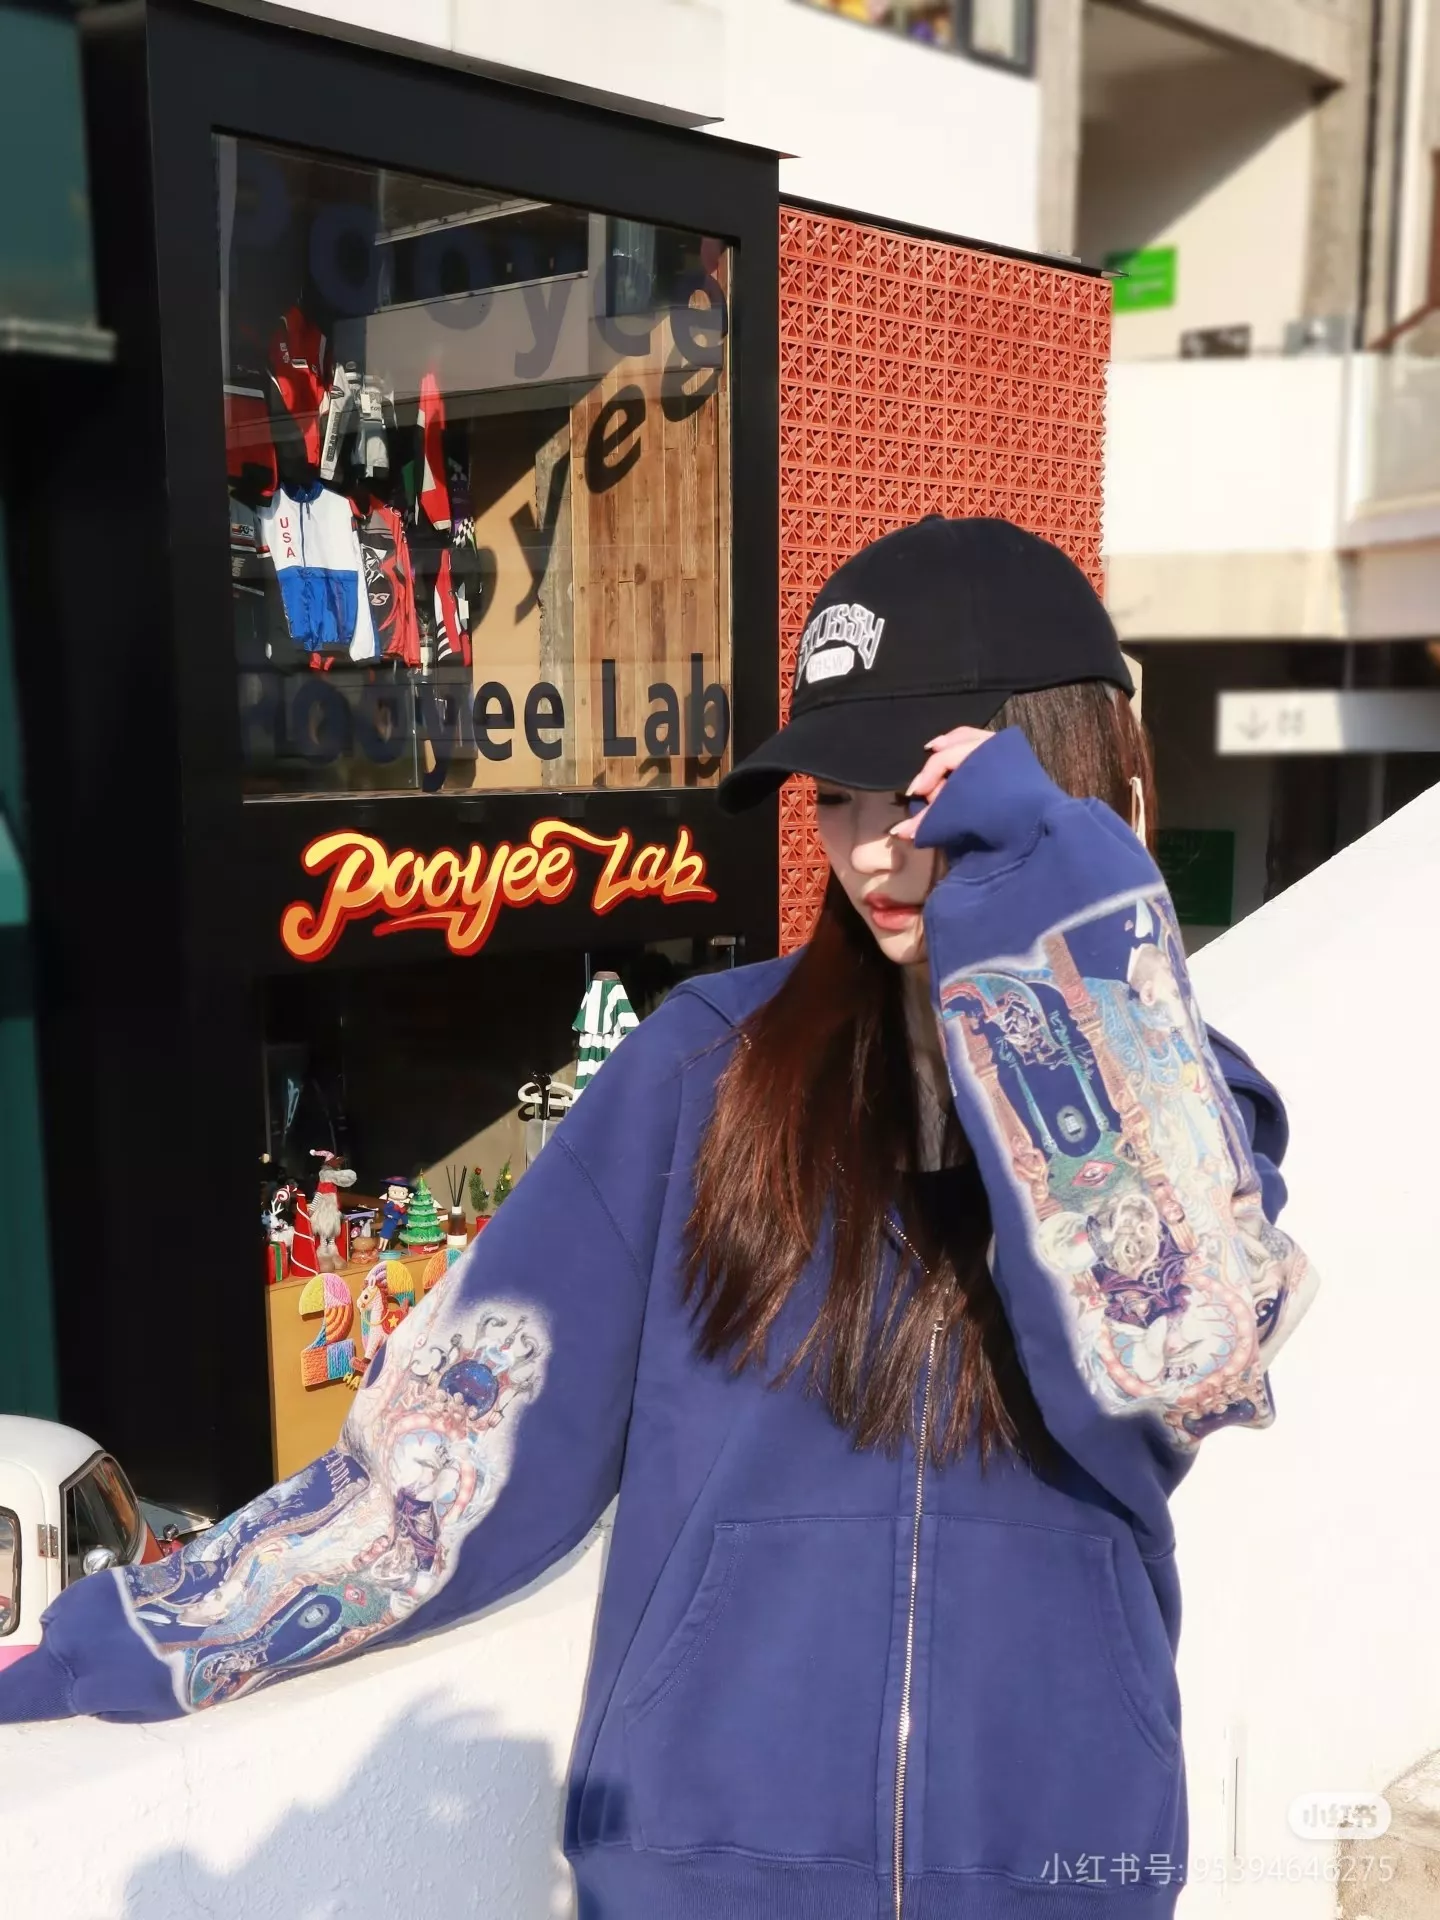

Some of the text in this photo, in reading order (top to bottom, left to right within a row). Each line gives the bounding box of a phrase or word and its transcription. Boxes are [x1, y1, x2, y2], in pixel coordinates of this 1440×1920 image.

[602, 652, 730, 758] Lab
[281, 818, 717, 963] Pooyee Lab
